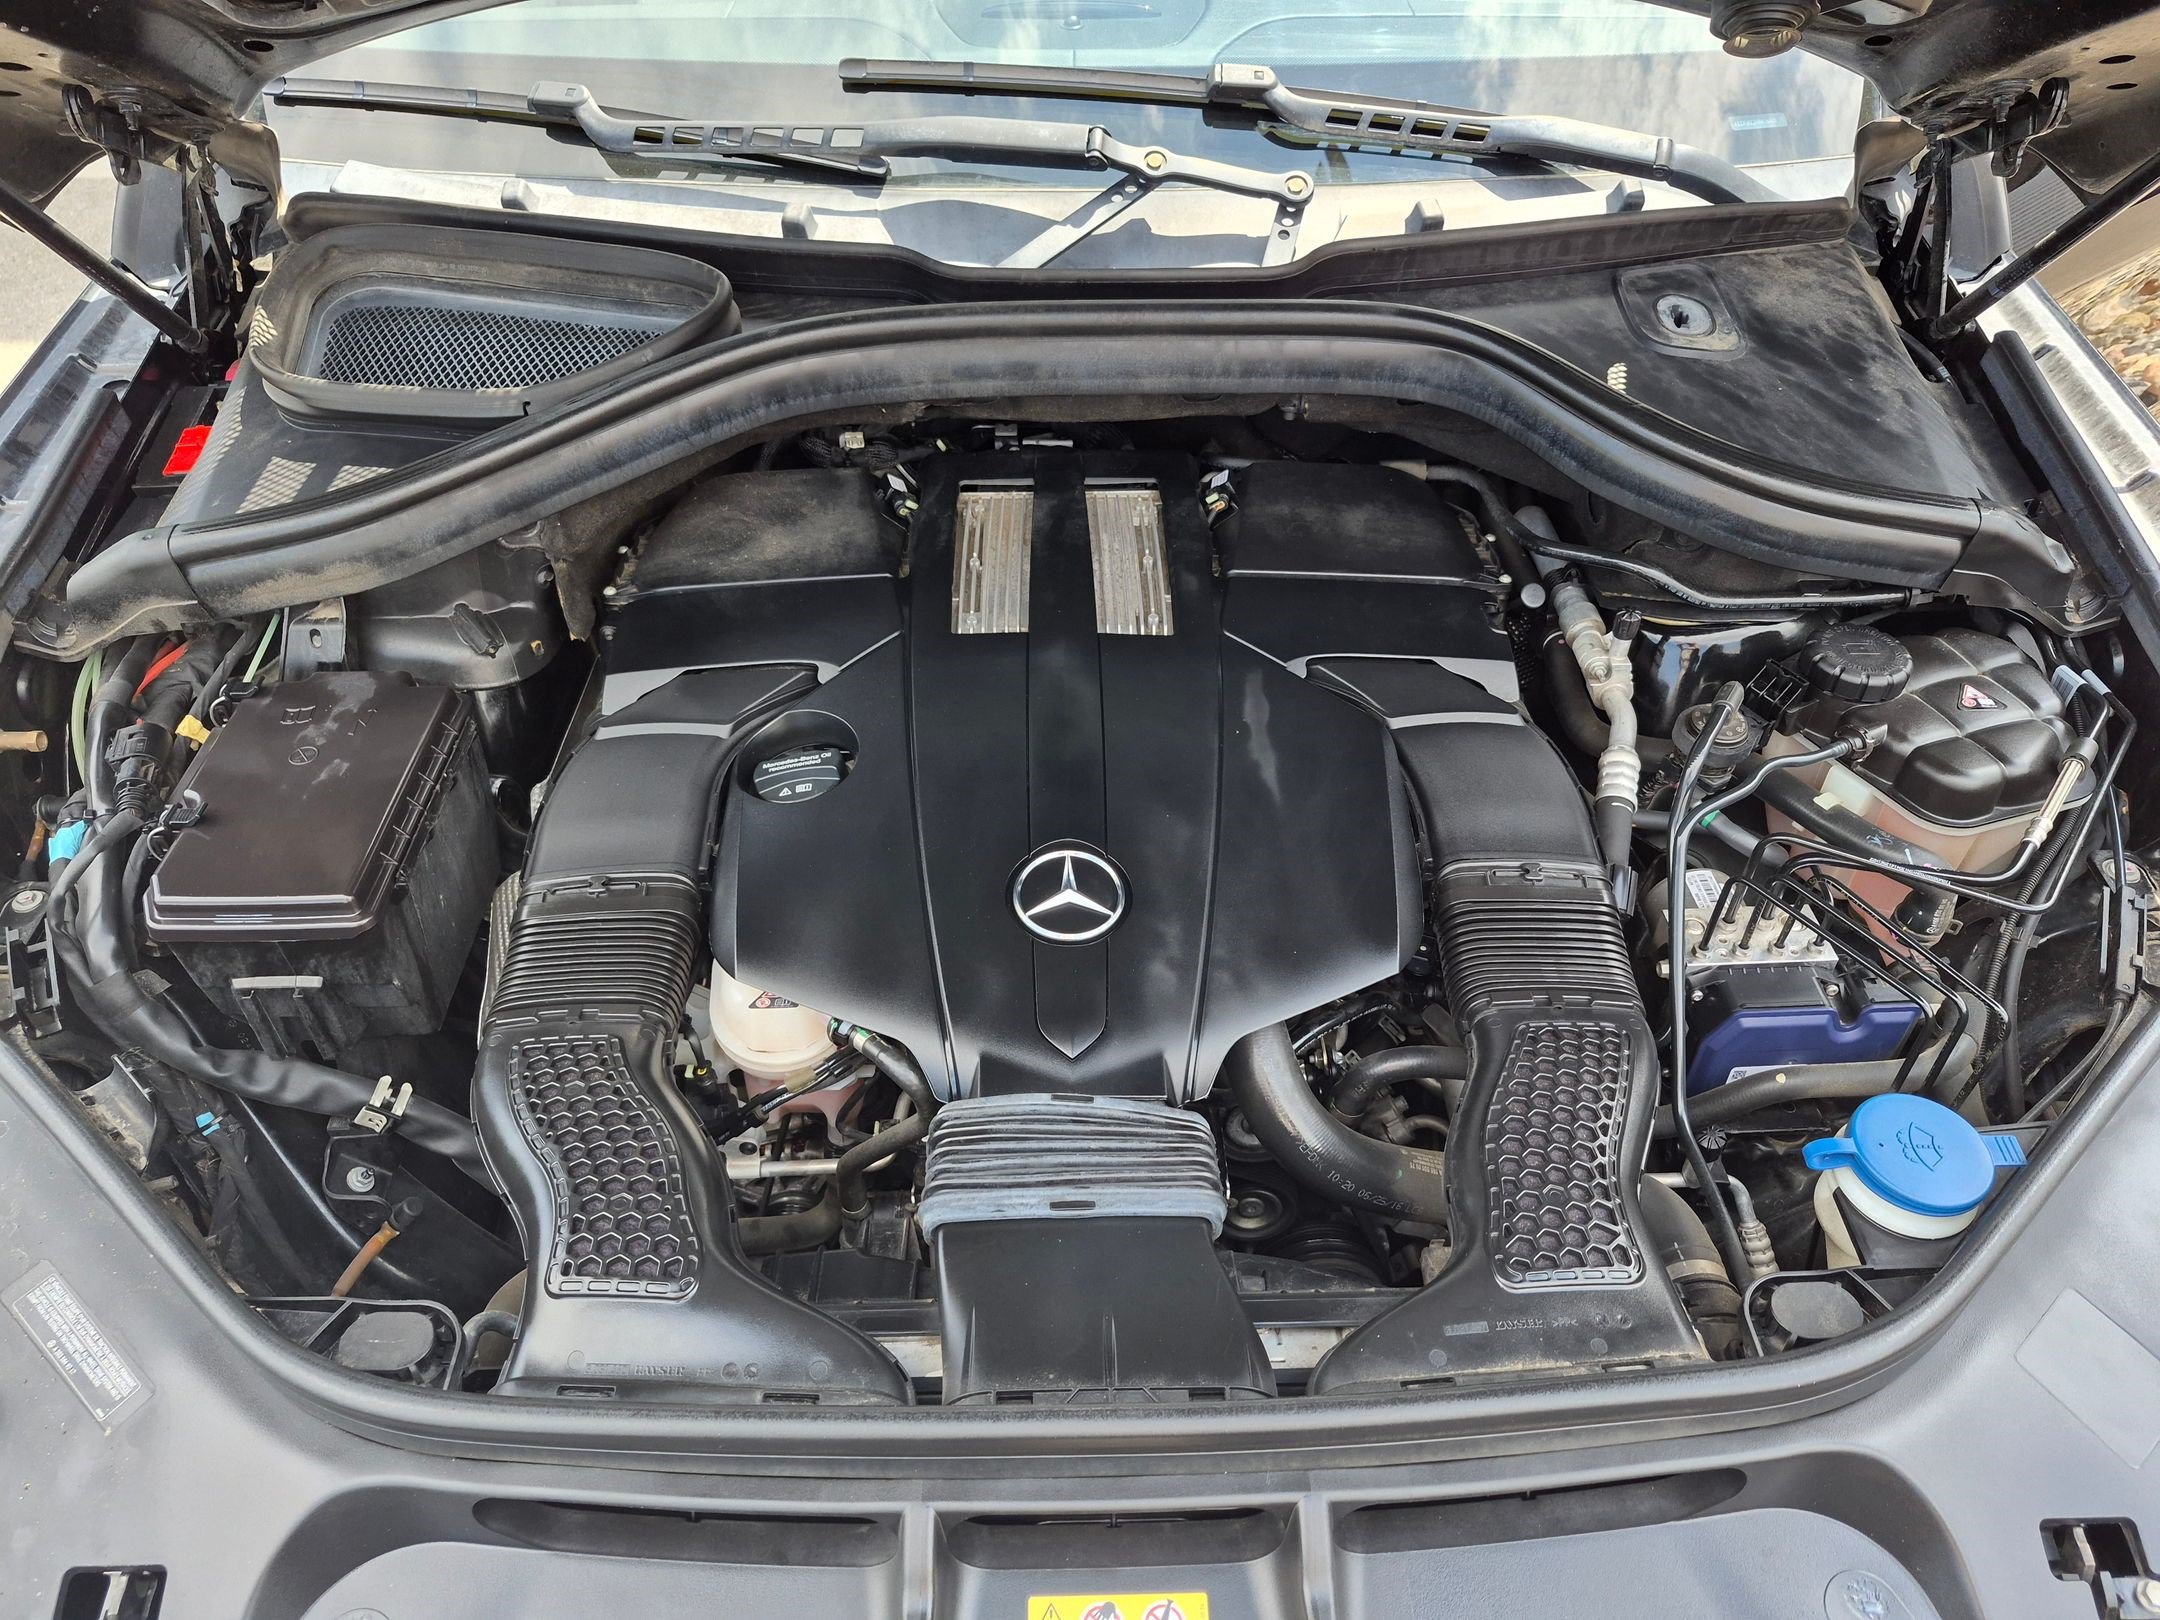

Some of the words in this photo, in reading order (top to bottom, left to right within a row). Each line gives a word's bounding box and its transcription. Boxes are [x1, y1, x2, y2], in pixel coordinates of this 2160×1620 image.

[763, 755, 819, 769] Mercedes-Benz
[769, 759, 821, 772] recommended
[1327, 1170, 1355, 1192] 10:20
